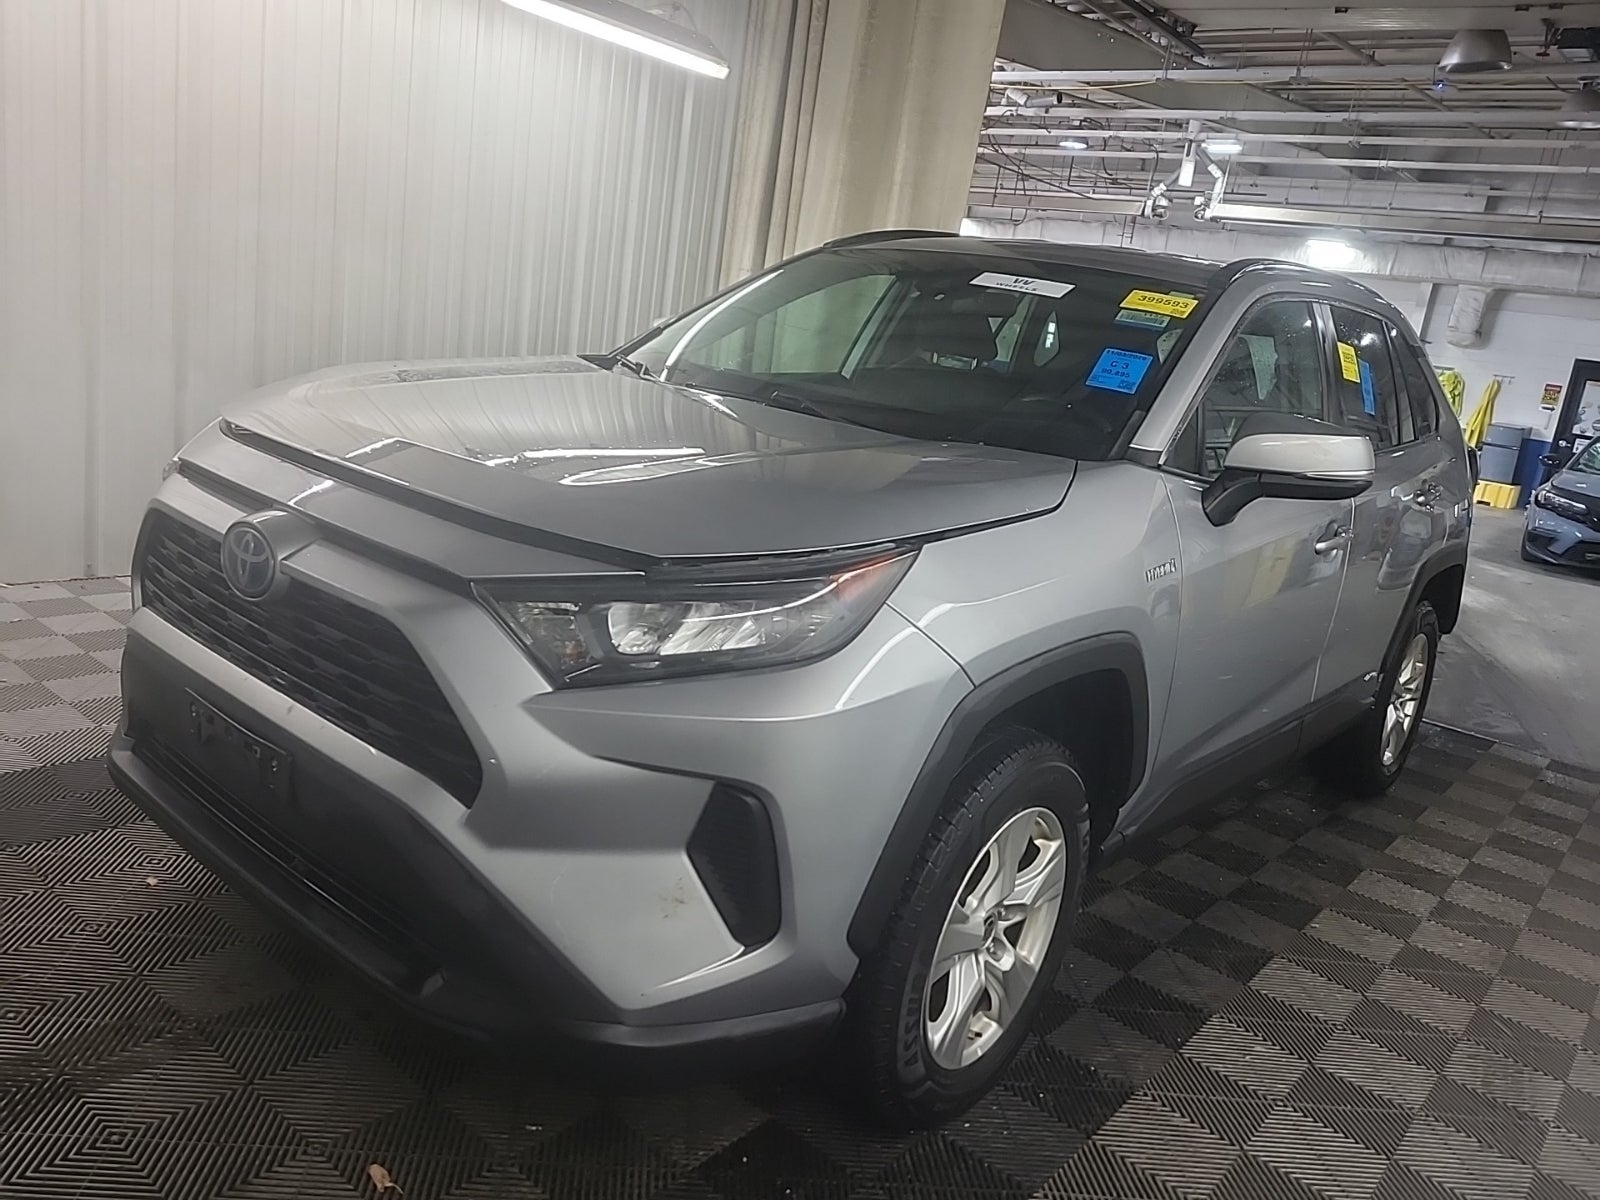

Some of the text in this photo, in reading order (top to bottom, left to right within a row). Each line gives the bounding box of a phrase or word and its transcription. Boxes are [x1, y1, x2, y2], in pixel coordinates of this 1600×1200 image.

[996, 282, 1037, 291] WHEELS
[1138, 295, 1190, 309] 399593
[1110, 360, 1130, 370] C 3
